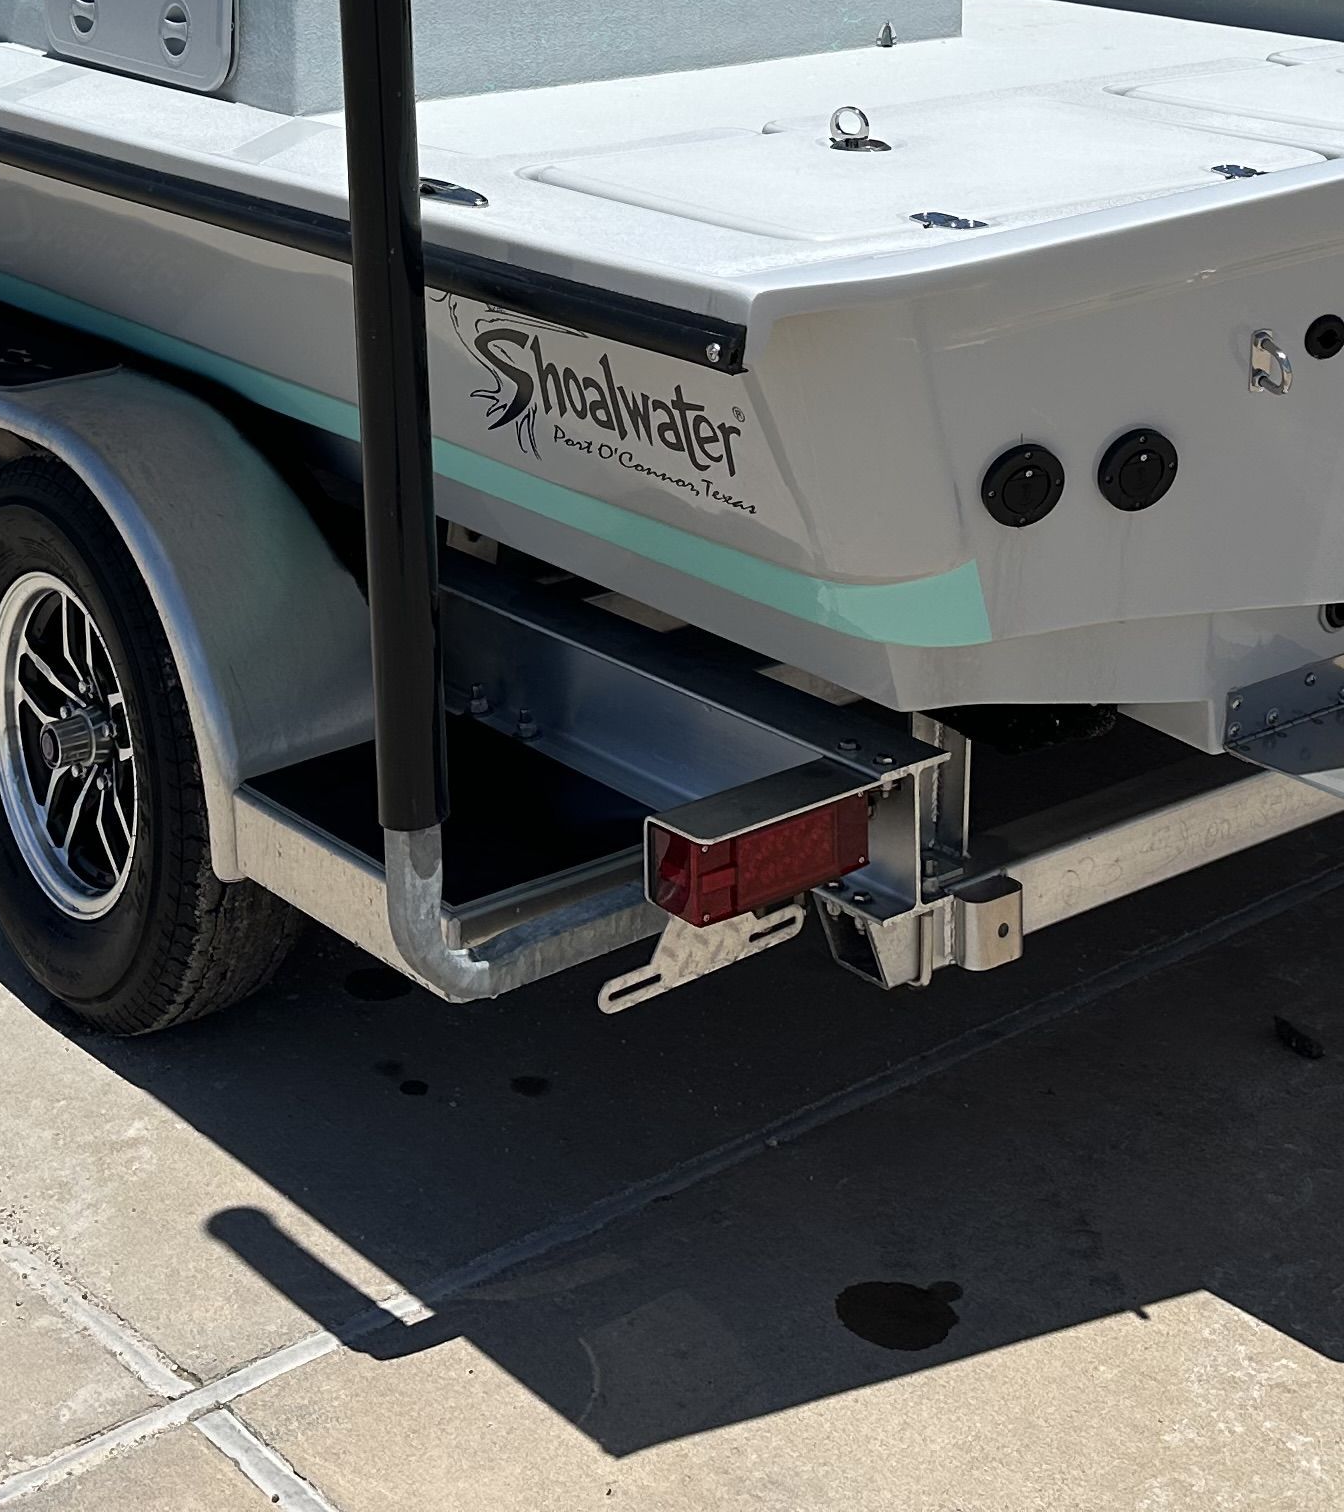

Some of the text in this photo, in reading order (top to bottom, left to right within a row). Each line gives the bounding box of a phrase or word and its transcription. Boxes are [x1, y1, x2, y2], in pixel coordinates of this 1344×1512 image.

[474, 328, 741, 477] Shoalwater
[553, 424, 593, 454] Port
[701, 478, 757, 515] Texas
